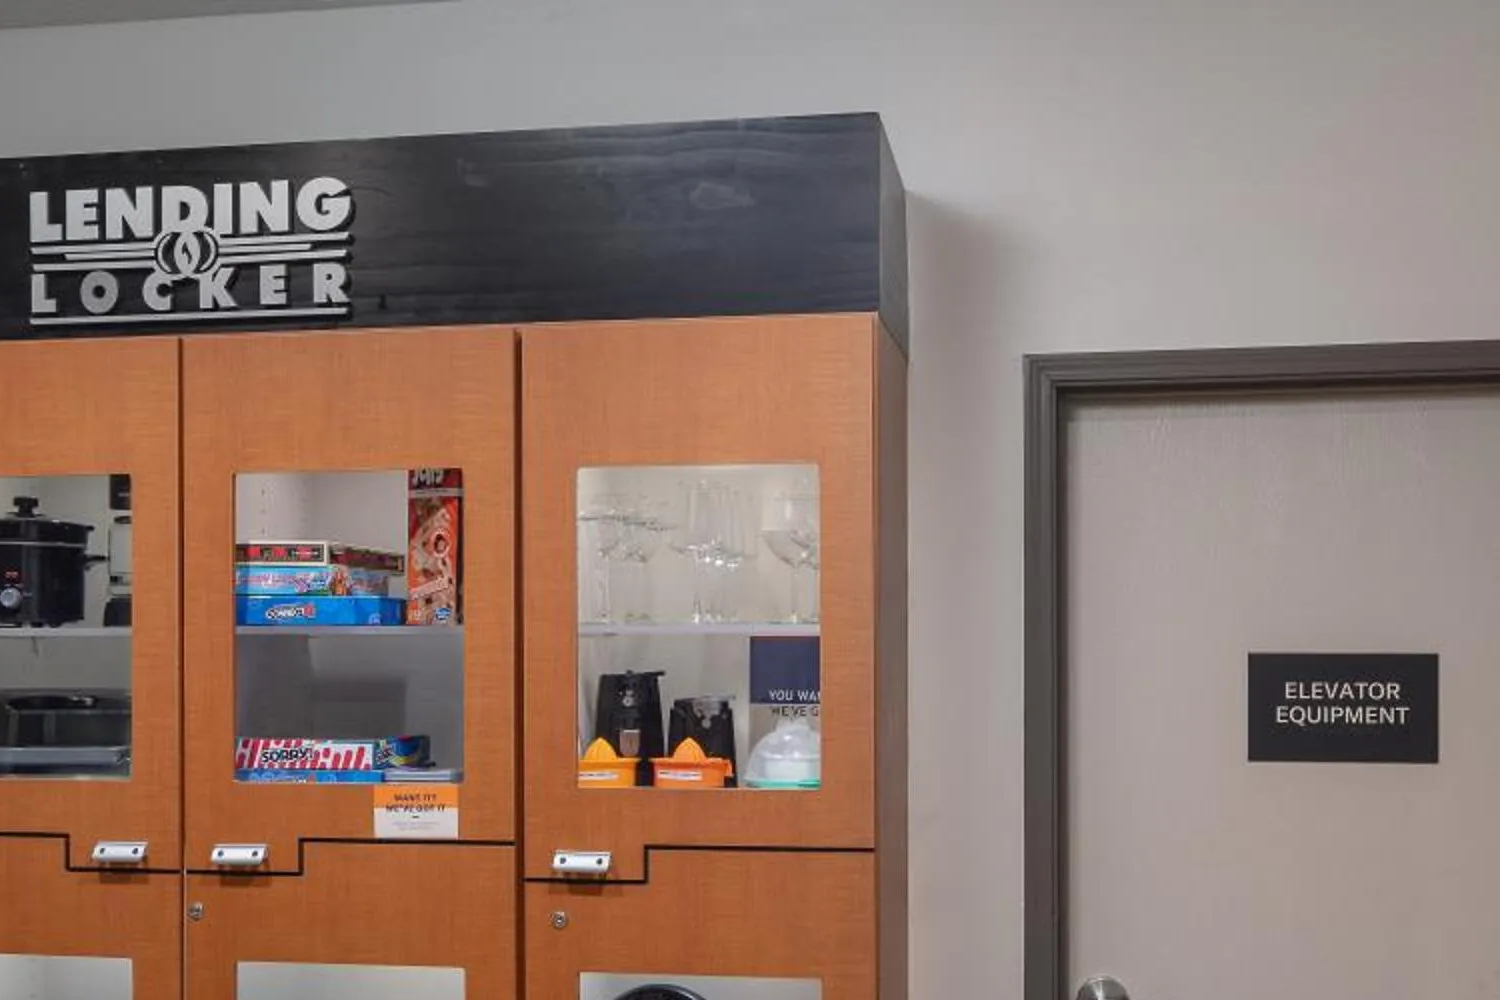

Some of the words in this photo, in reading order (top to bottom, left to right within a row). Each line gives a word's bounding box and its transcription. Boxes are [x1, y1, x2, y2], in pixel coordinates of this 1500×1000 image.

[29, 177, 351, 242] LENDING
[31, 263, 350, 314] LOCKER
[769, 689, 793, 701] YOU
[798, 690, 820, 702] WA
[1285, 681, 1400, 700] ELEVATOR
[1276, 705, 1410, 727] EQUIPMENT
